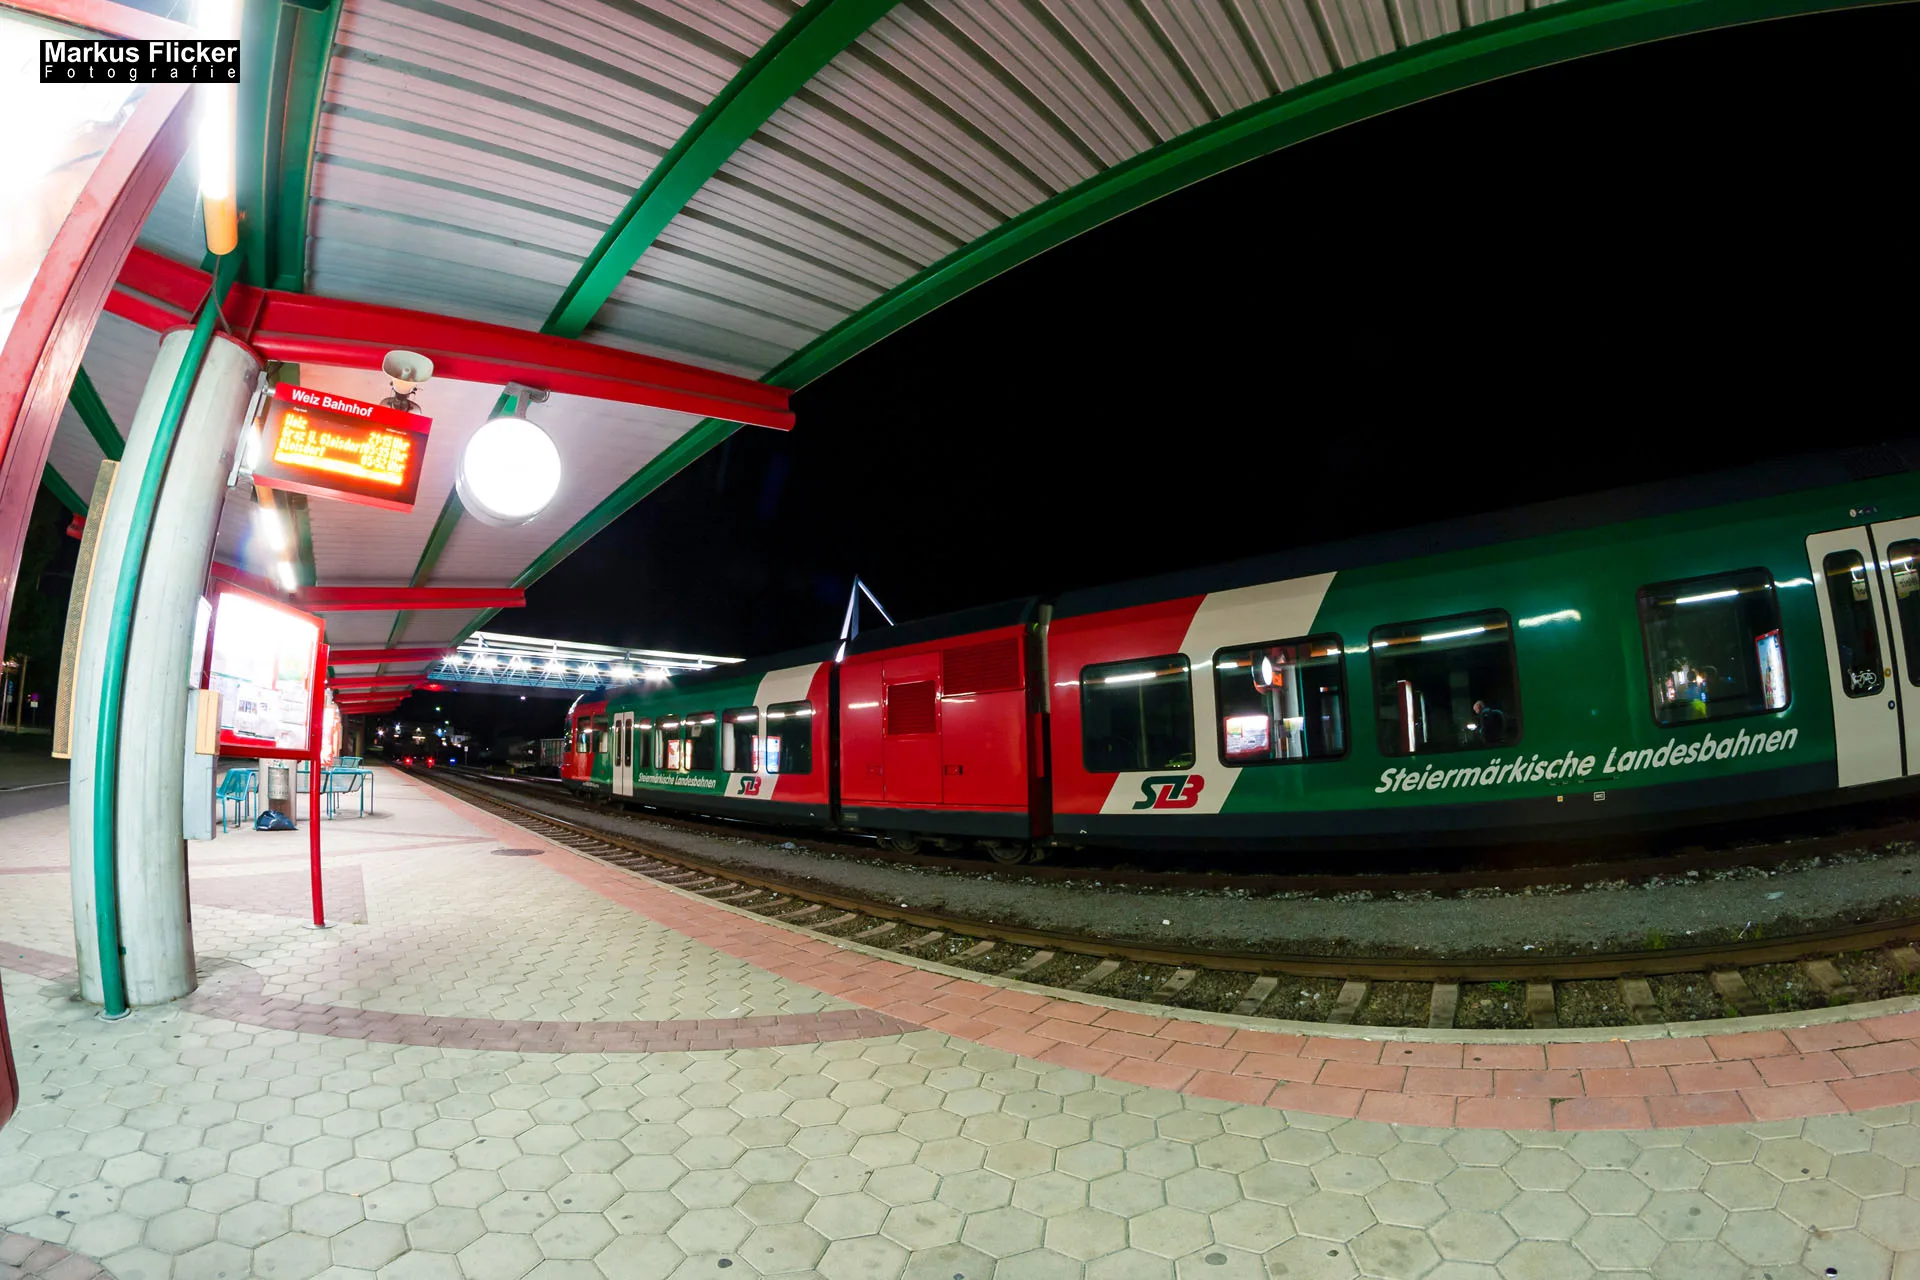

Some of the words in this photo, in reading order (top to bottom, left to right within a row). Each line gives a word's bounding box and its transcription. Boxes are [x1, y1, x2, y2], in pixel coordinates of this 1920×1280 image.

[292, 389, 320, 406] Weiz
[322, 396, 373, 418] Bahnhof
[285, 413, 308, 430] Weiz
[1375, 750, 1596, 793] Steiermärkische
[1602, 727, 1799, 775] Landesbahnen
[674, 774, 717, 788] Landesbahnen
